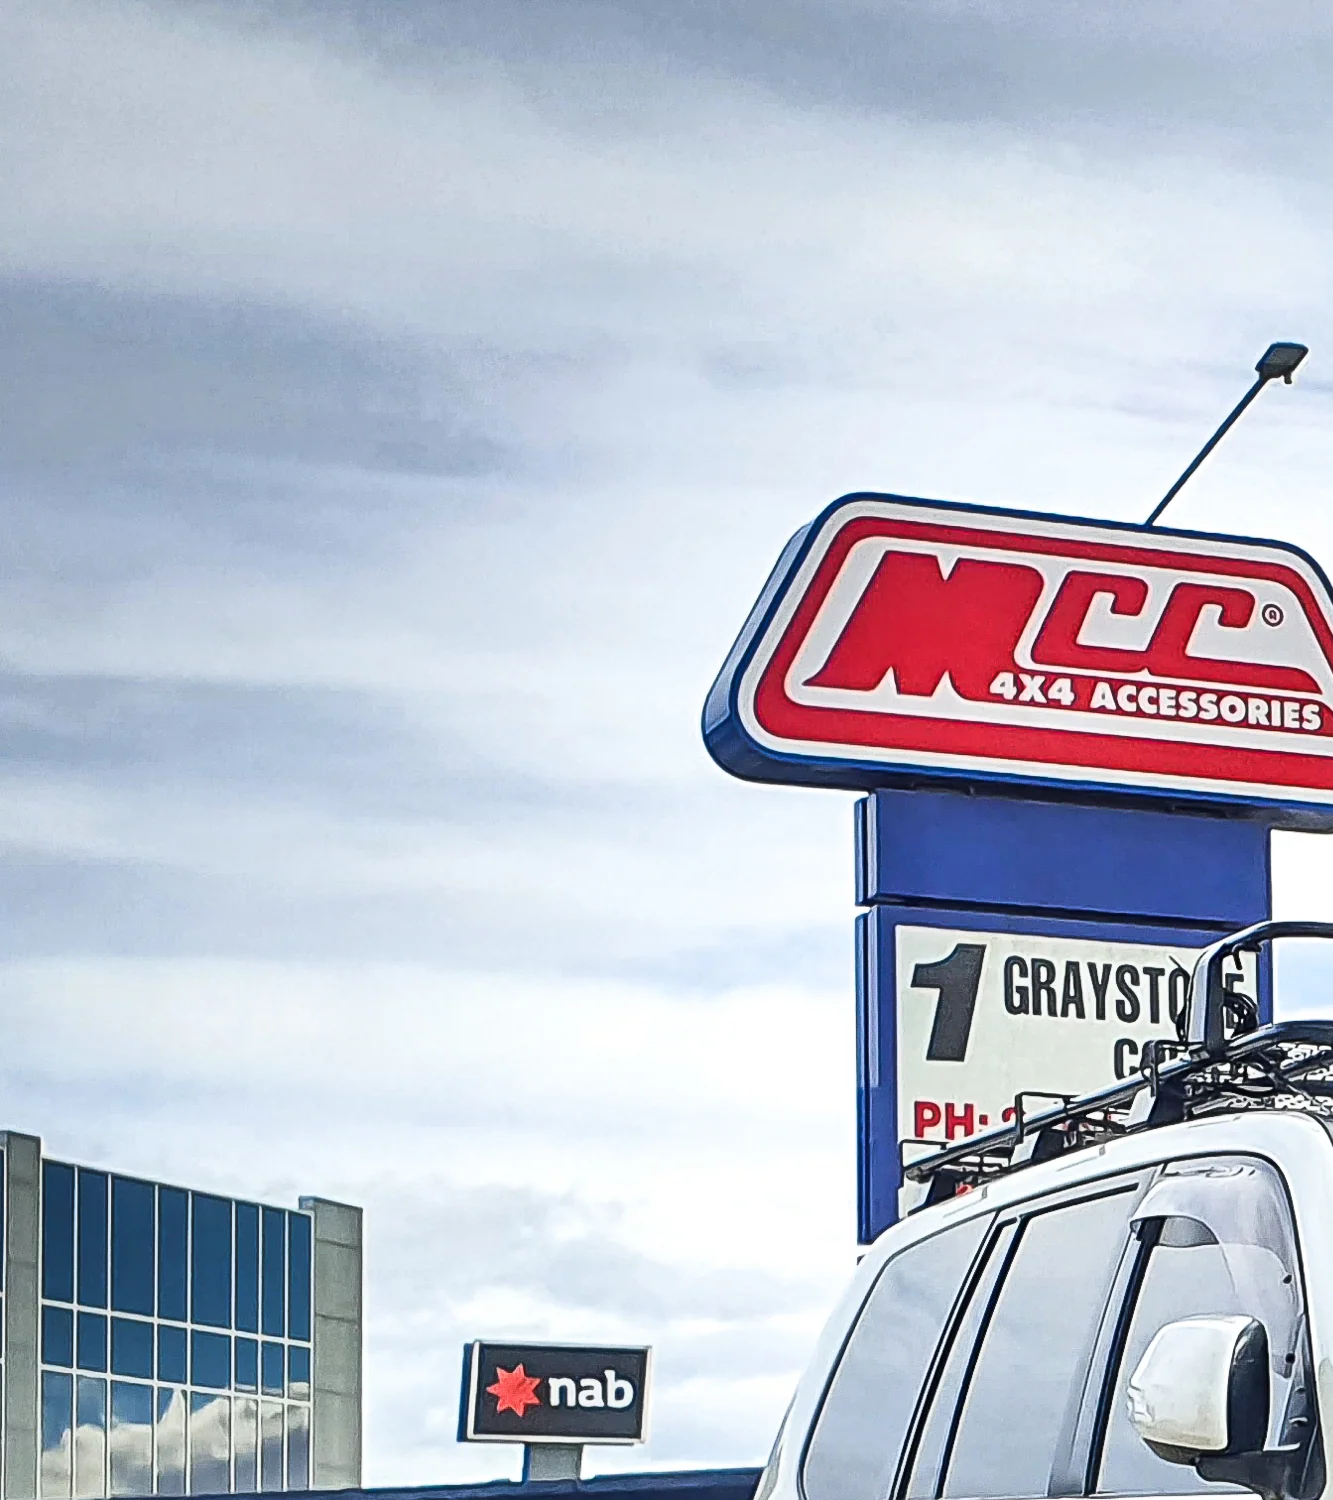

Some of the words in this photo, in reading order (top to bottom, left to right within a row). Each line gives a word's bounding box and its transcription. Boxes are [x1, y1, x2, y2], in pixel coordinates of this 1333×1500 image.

[803, 551, 1320, 696] MCC
[990, 671, 1075, 706] 4X4
[1090, 682, 1322, 731] ACCESSORIES
[911, 943, 987, 1062] 1
[549, 1370, 634, 1408] nab
